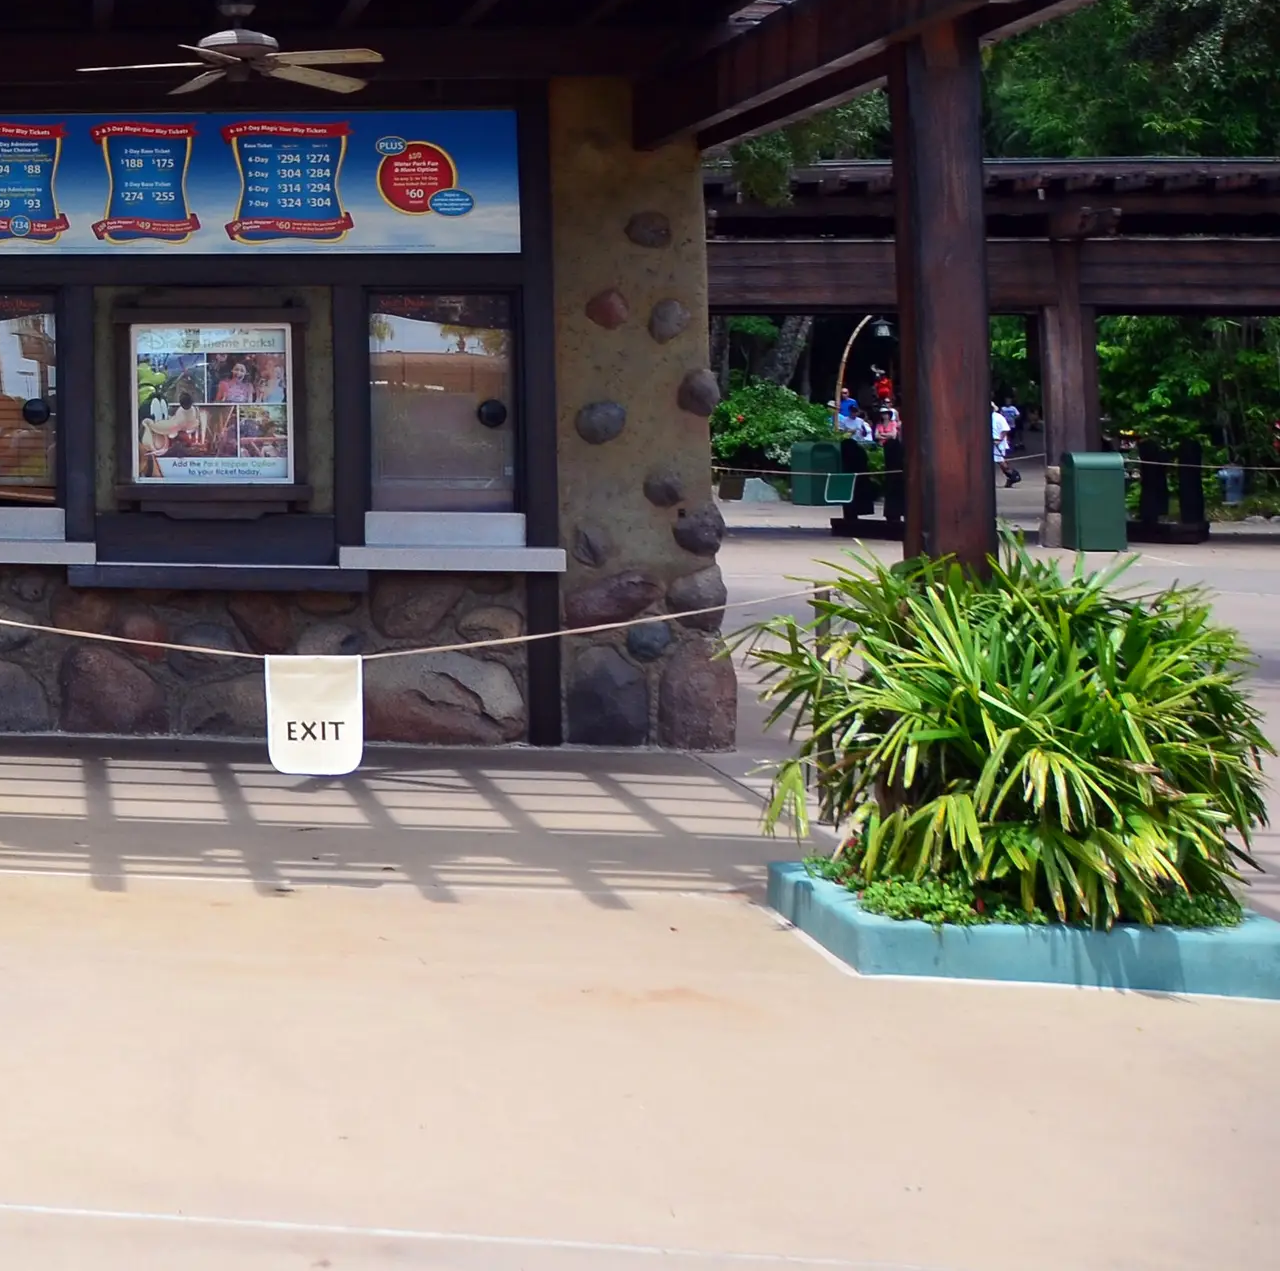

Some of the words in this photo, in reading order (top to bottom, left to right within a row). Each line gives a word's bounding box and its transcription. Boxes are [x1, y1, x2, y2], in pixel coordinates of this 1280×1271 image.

[379, 142, 403, 150] PLUS
[277, 154, 300, 163] $294
[306, 154, 330, 163] $274
[121, 159, 143, 168] $188
[152, 159, 174, 167] $175
[24, 165, 41, 173] $88
[277, 169, 301, 178] $304
[306, 169, 330, 177] $284
[278, 184, 301, 193] $314
[307, 183, 330, 192] $294
[121, 192, 143, 201] $274
[152, 192, 174, 201] $255
[405, 189, 423, 198] $60
[24, 199, 41, 208] $93
[277, 198, 301, 207] $324
[307, 198, 331, 207] $304
[173, 460, 187, 468] Add
[288, 721, 344, 740] EXIT
